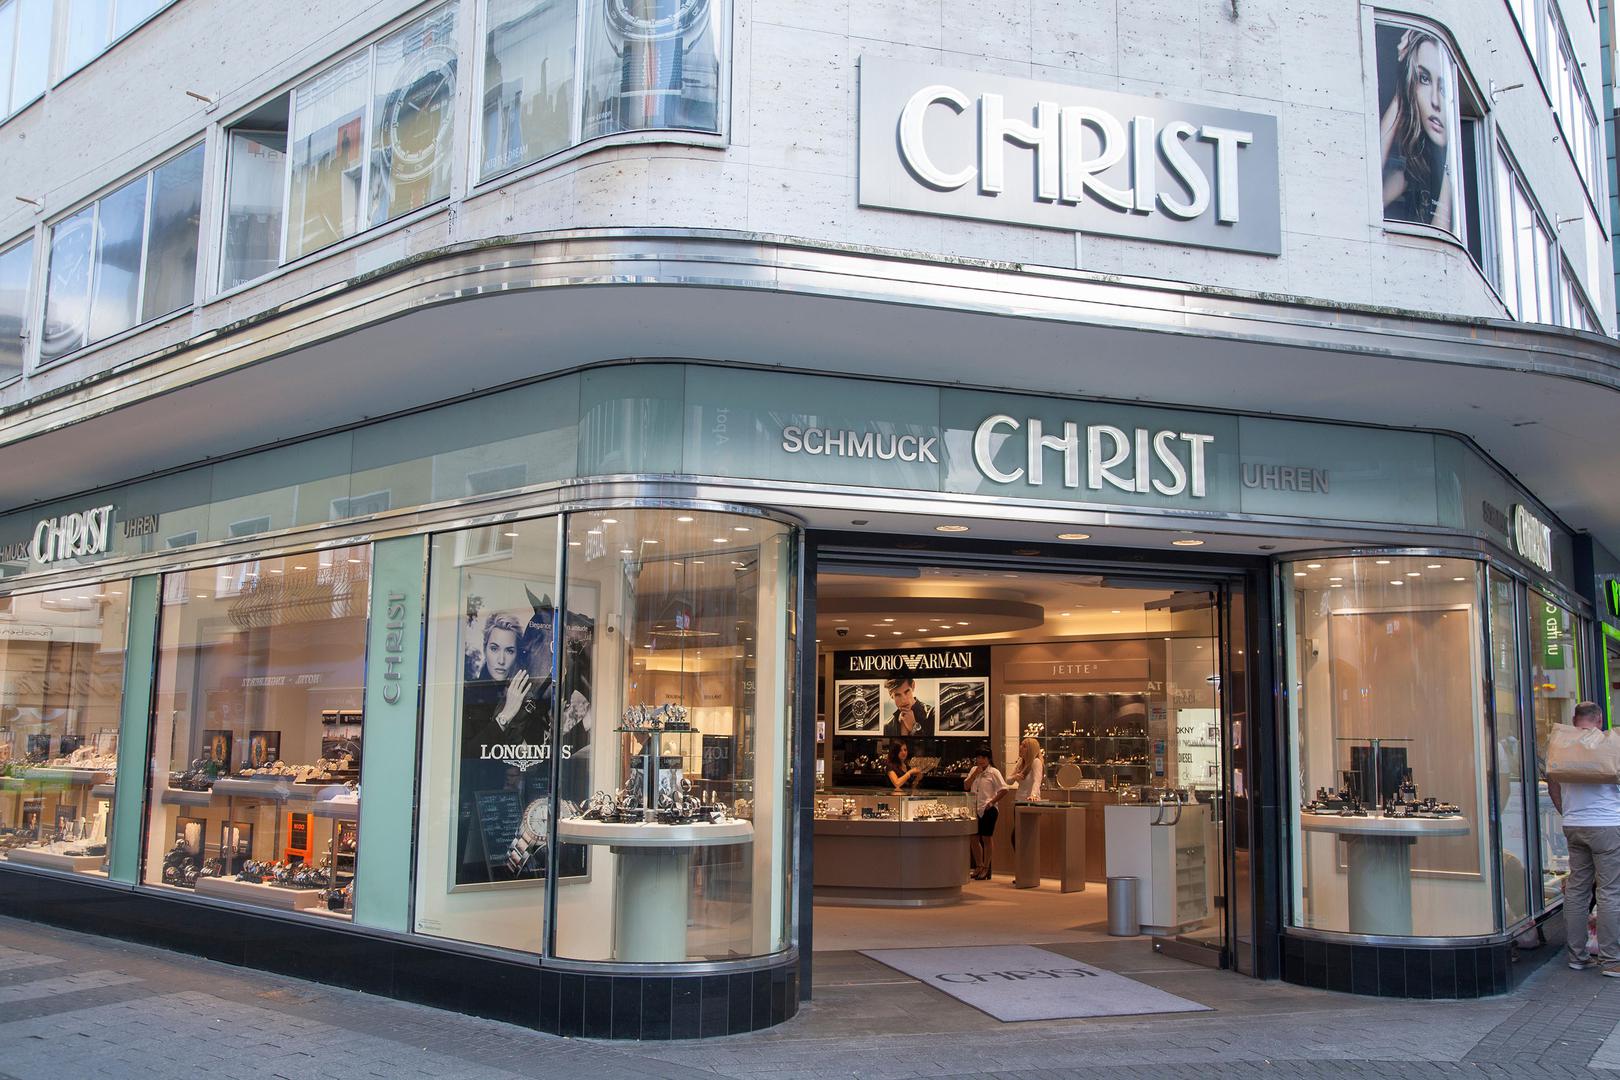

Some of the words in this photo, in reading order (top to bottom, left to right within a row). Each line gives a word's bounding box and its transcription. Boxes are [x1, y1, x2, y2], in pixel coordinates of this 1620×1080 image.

[898, 84, 1252, 224] CHRIST
[782, 425, 938, 464] SCHMUCK
[973, 415, 1215, 497] CHRIST
[1241, 463, 1330, 494] UHREN
[32, 504, 114, 564] CHRIST
[123, 513, 160, 538] UHREN
[383, 589, 406, 705] CHRIST
[850, 654, 902, 672] EMPORIO
[919, 652, 973, 669] ARMANI
